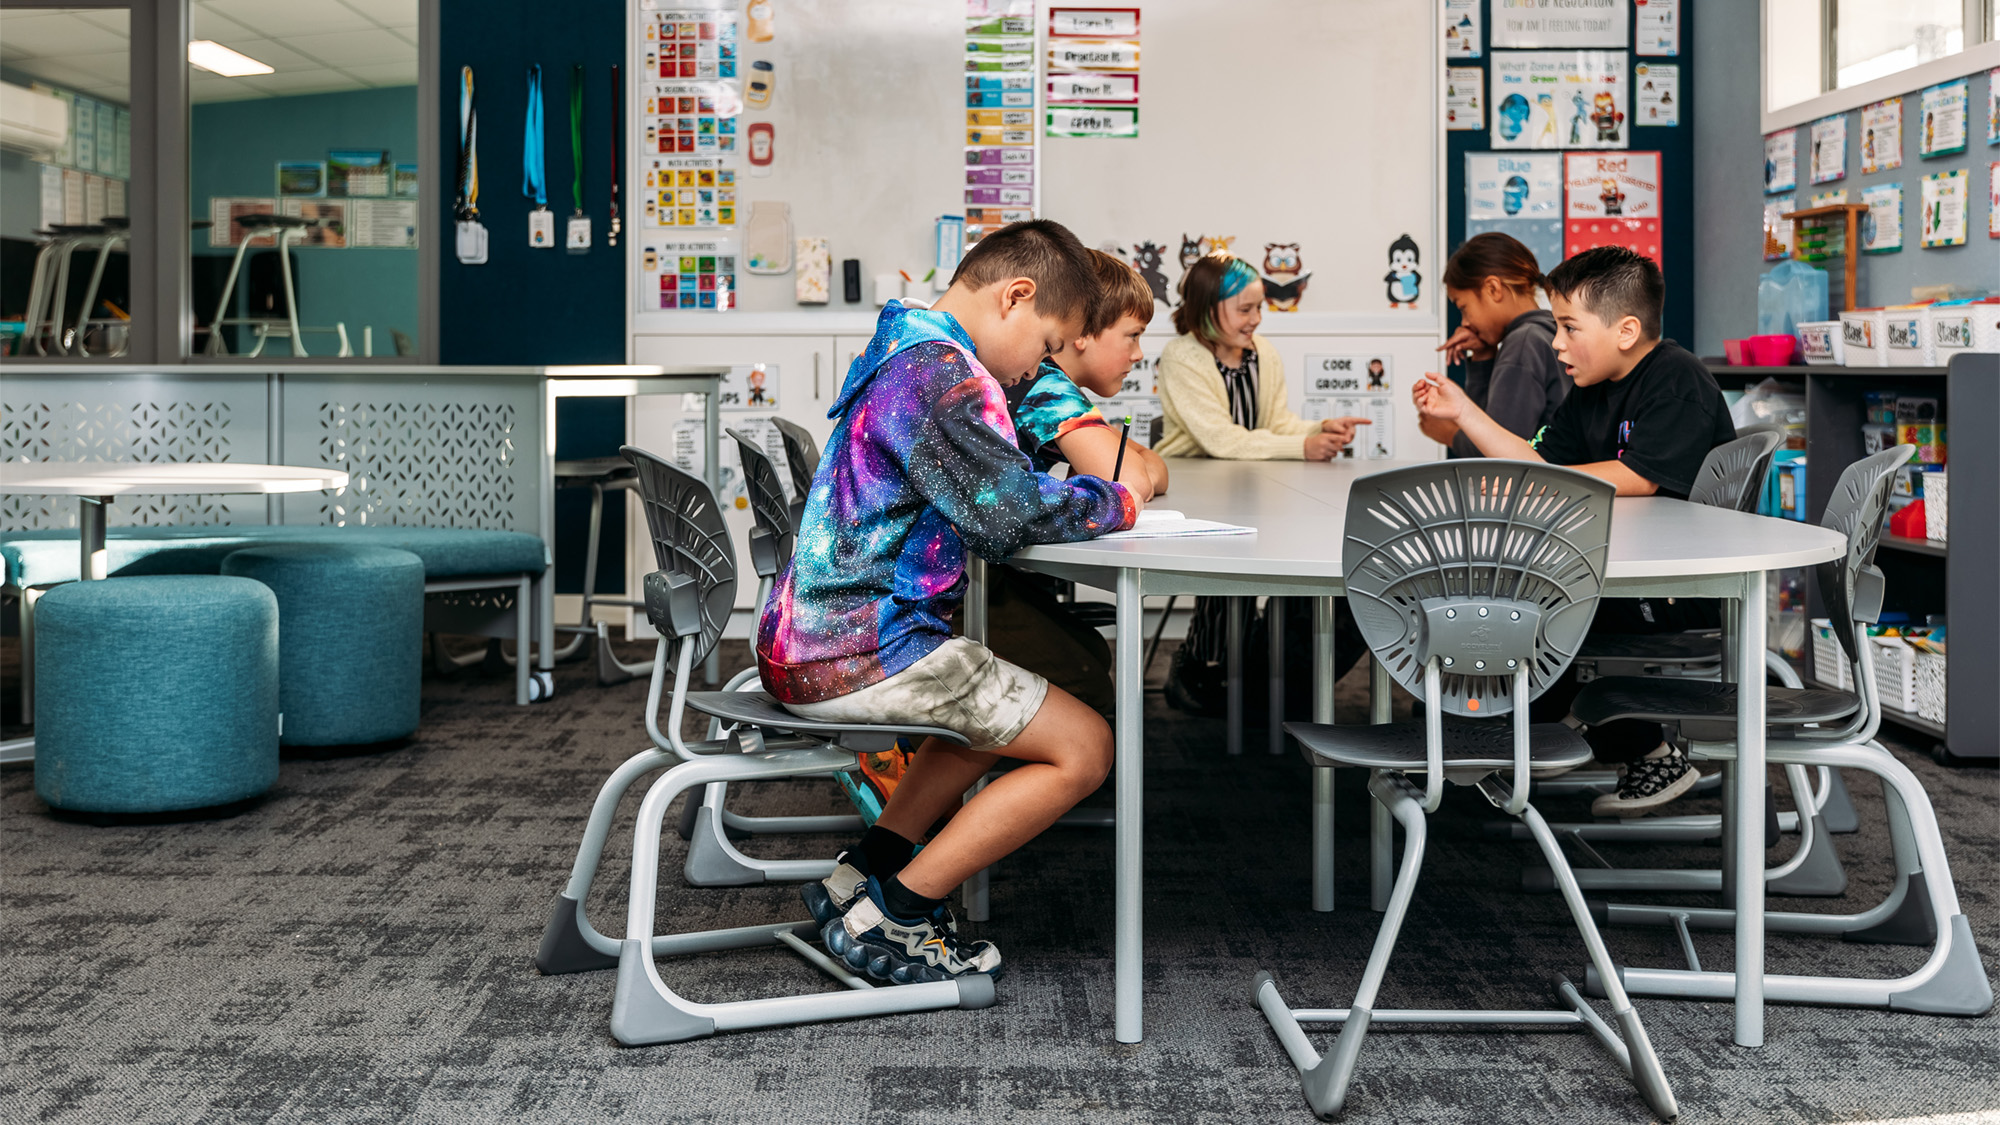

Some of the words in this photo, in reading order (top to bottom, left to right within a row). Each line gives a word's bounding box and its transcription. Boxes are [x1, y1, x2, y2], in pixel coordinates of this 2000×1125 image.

[1506, 19, 1522, 31] HOW
[1526, 20, 1539, 31] AM
[1549, 19, 1580, 31] FEELING
[1583, 19, 1612, 31] TODAY?
[1499, 61, 1526, 71] What
[1529, 61, 1556, 71] Zone
[1559, 62, 1577, 71] Are
[1503, 75, 1522, 83] Blue
[1530, 74, 1557, 84] Green
[1599, 75, 1616, 83] Red
[1497, 159, 1531, 173] Blue
[1597, 158, 1628, 173] Red
[1569, 176, 1602, 188] YELLING
[1573, 202, 1597, 212] MEAN
[1630, 201, 1649, 213] MAD
[1843, 319, 1863, 342] Stage
[1863, 320, 1872, 348] 4
[1888, 324, 1908, 344] Stage
[1908, 320, 1918, 348] 5
[1936, 321, 1960, 343] Stage
[1961, 317, 1971, 347] 6
[1323, 359, 1352, 371] CODE
[1316, 378, 1359, 390] GROUPS
